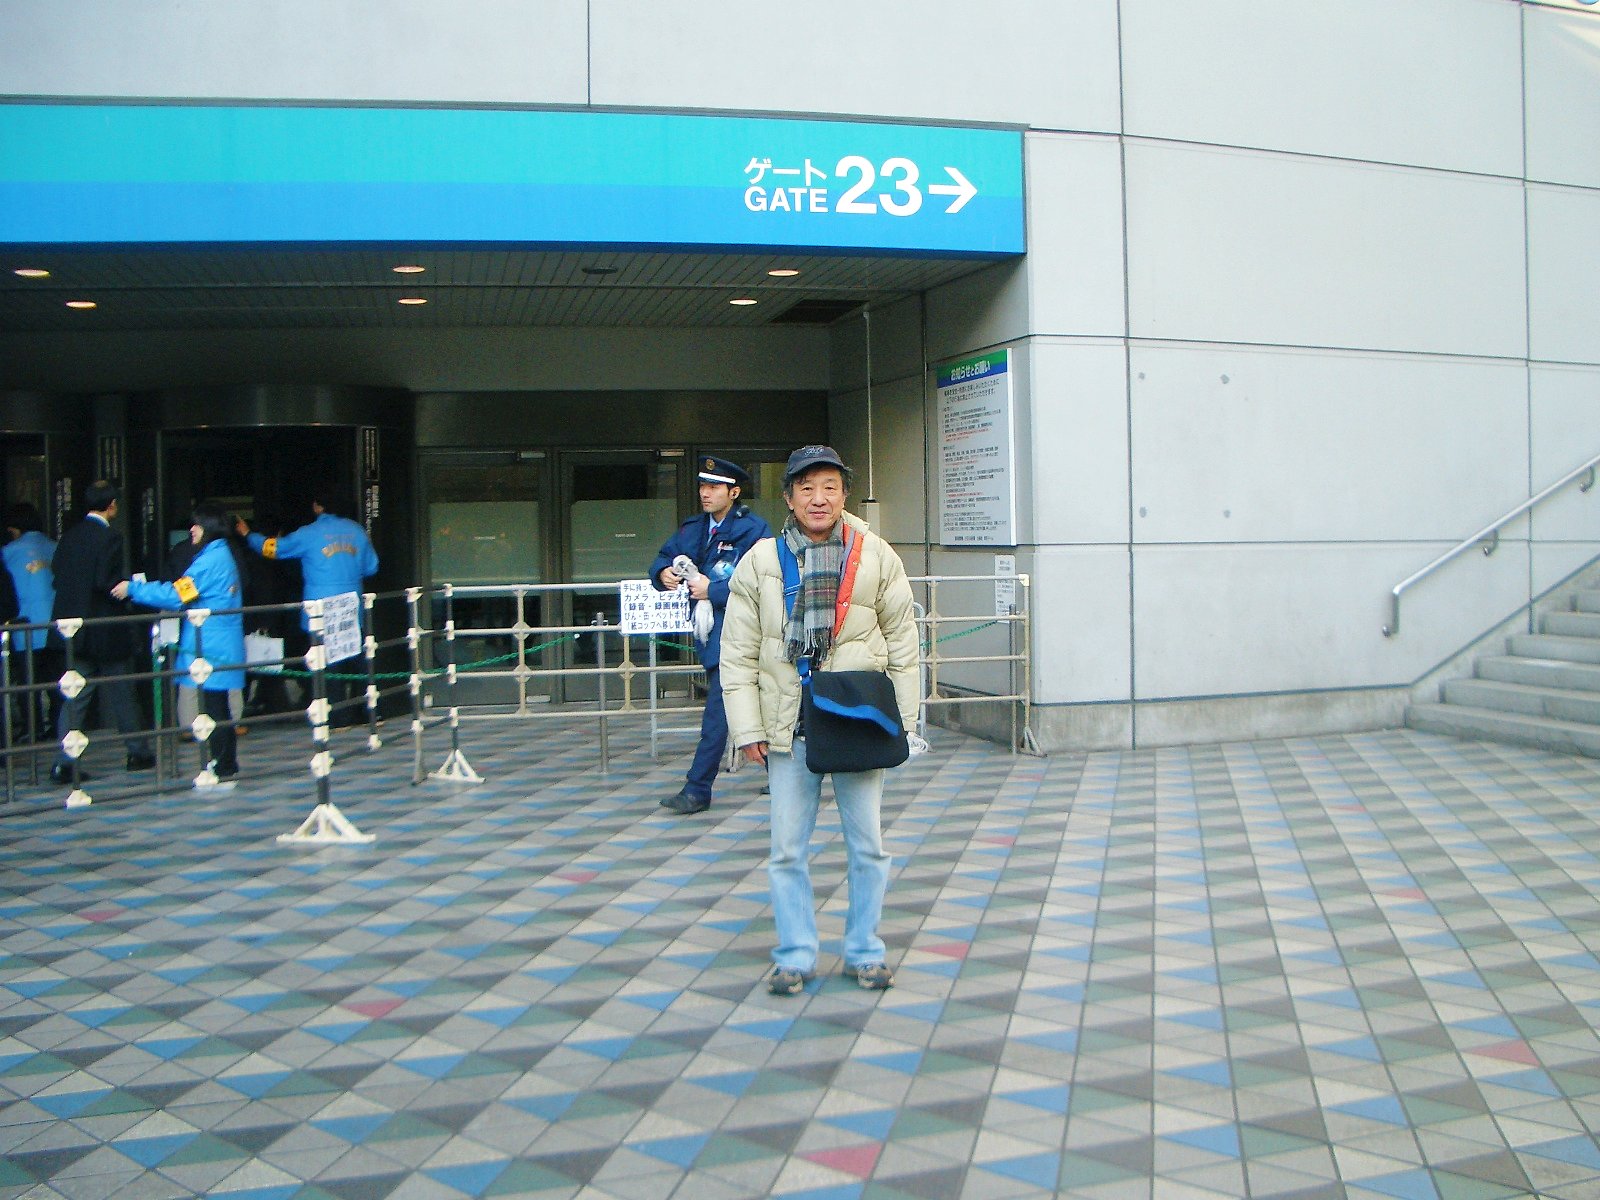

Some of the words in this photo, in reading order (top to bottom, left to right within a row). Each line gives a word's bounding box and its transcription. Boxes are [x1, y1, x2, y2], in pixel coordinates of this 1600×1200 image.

[744, 157, 828, 186] ゲート
[835, 155, 923, 217] 23
[744, 186, 829, 213] GATE
